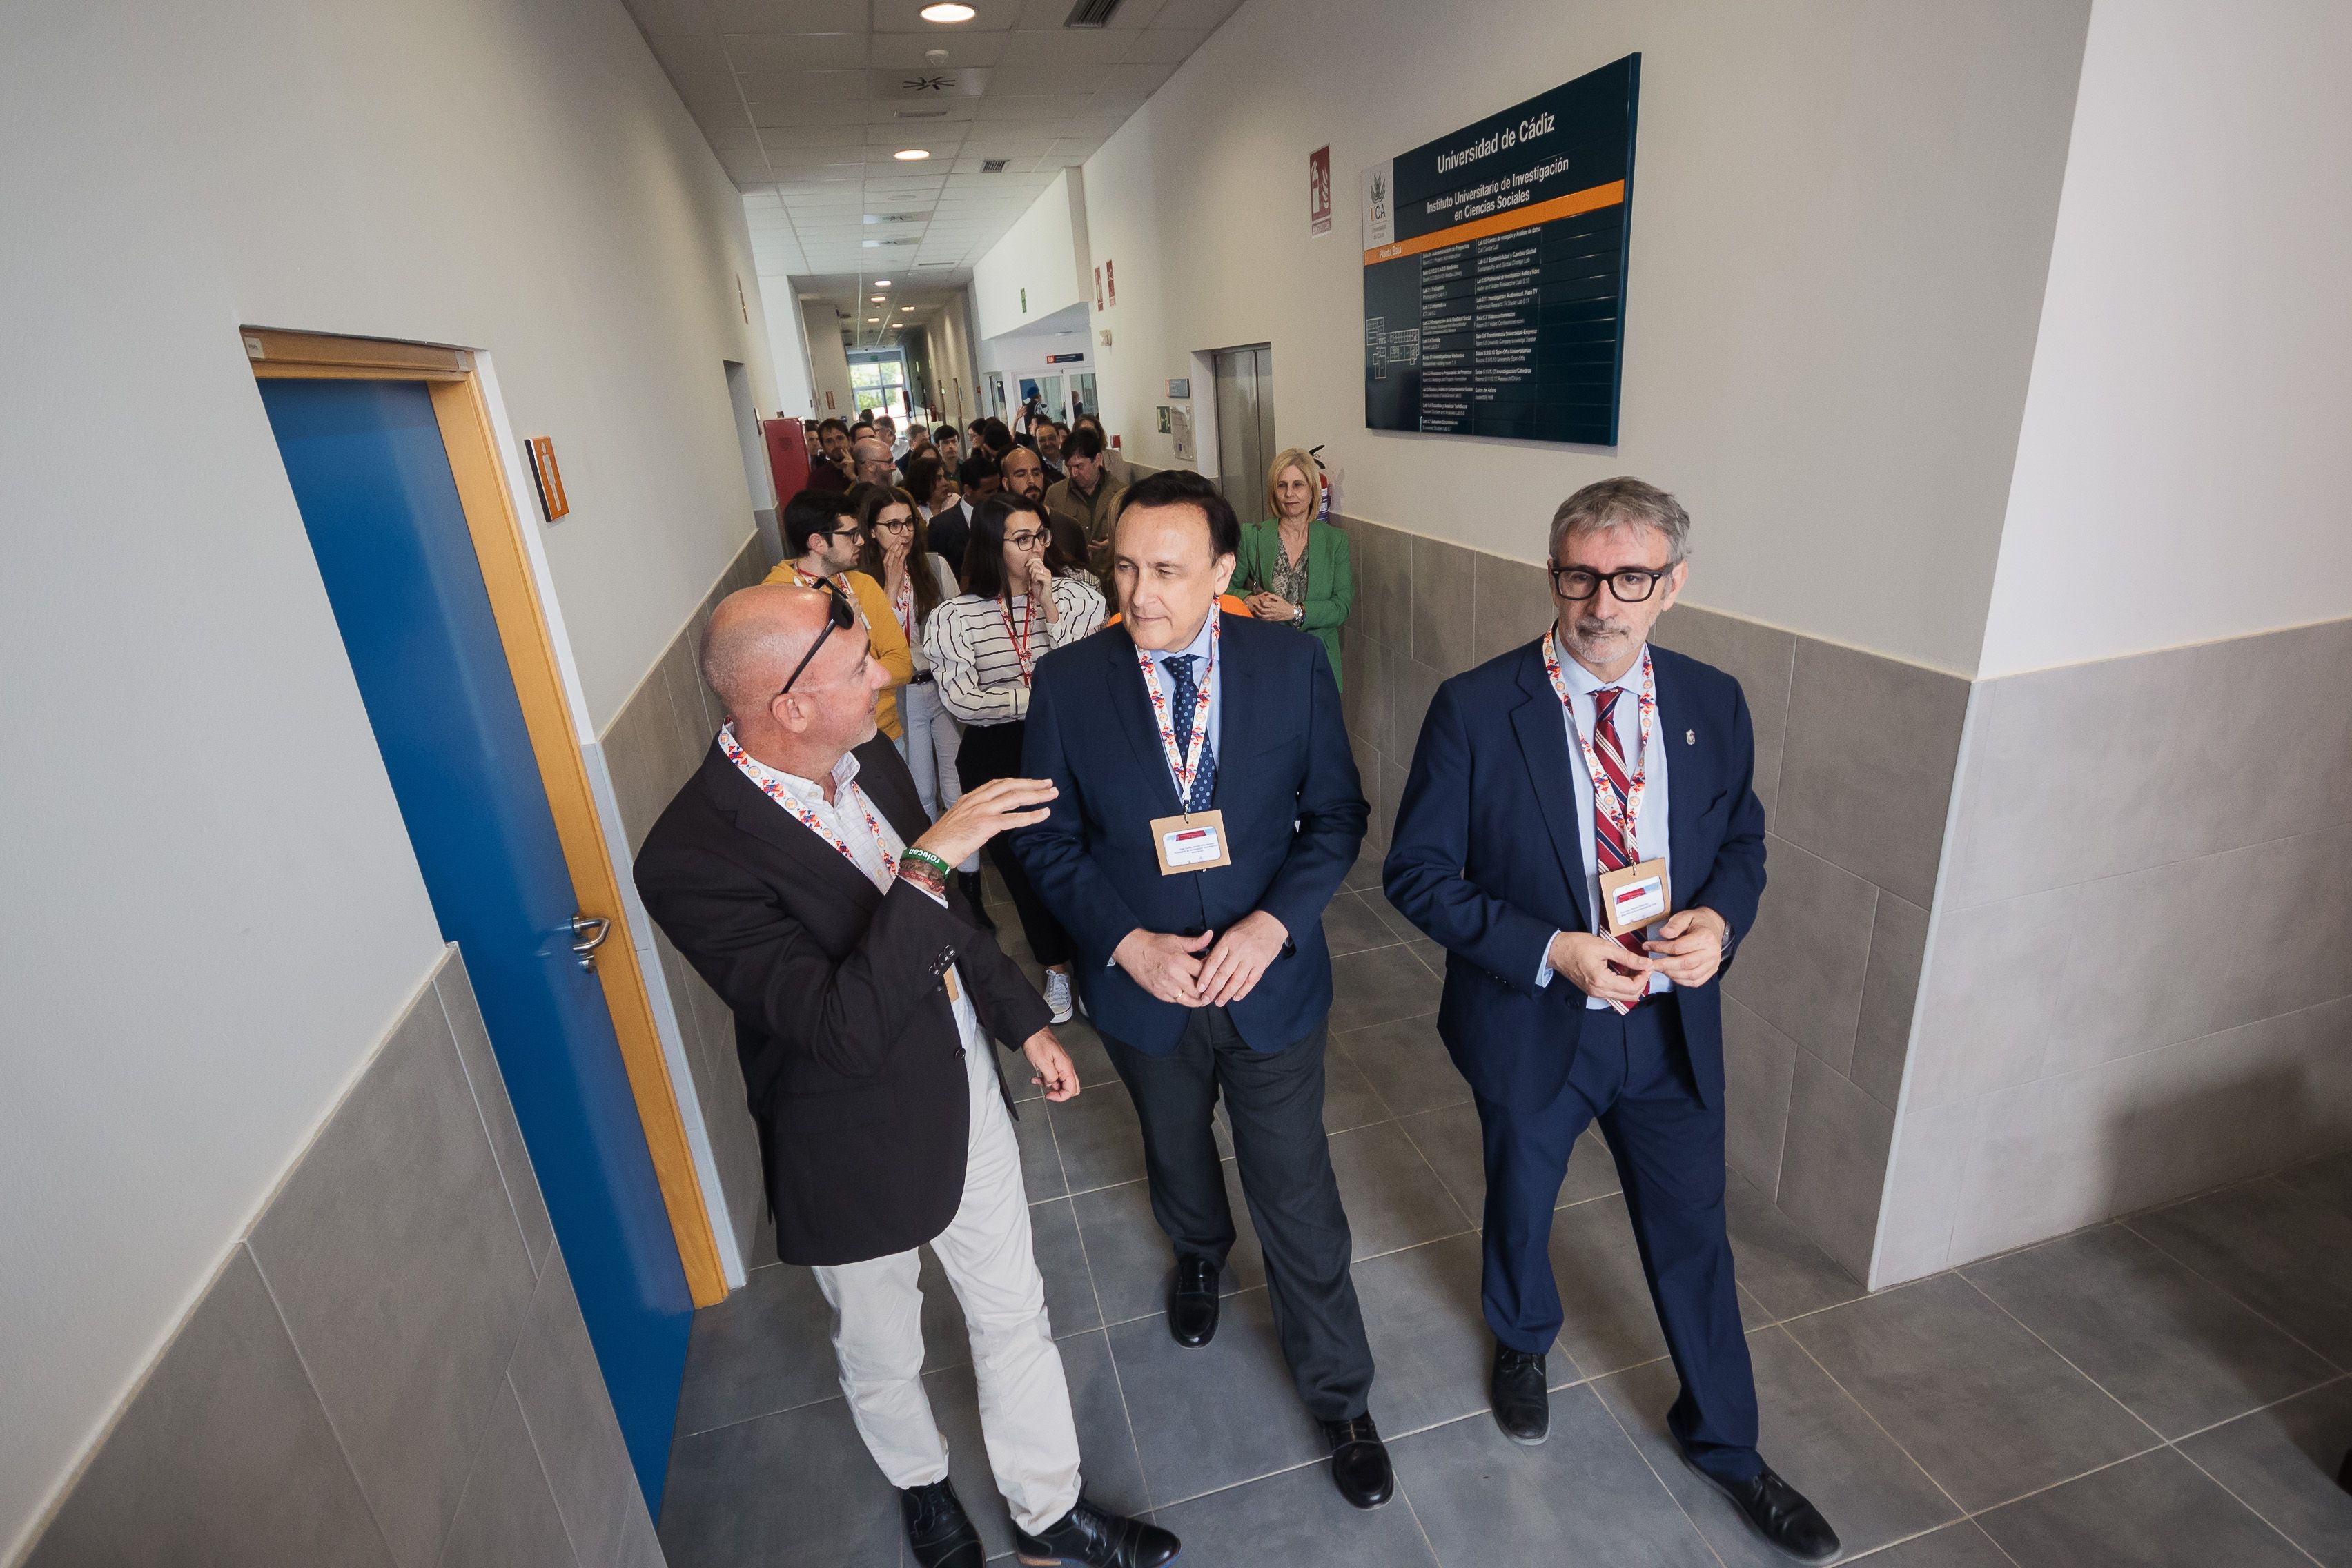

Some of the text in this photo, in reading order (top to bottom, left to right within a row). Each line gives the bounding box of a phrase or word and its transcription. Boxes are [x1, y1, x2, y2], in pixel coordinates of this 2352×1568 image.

[1438, 112, 1554, 173] Universidad de Cádiz
[1427, 157, 1569, 214] Instituto Universitario de Investigación
[1455, 190, 1529, 221] en Ciencias Sociales
[1380, 248, 1391, 258] Planta
